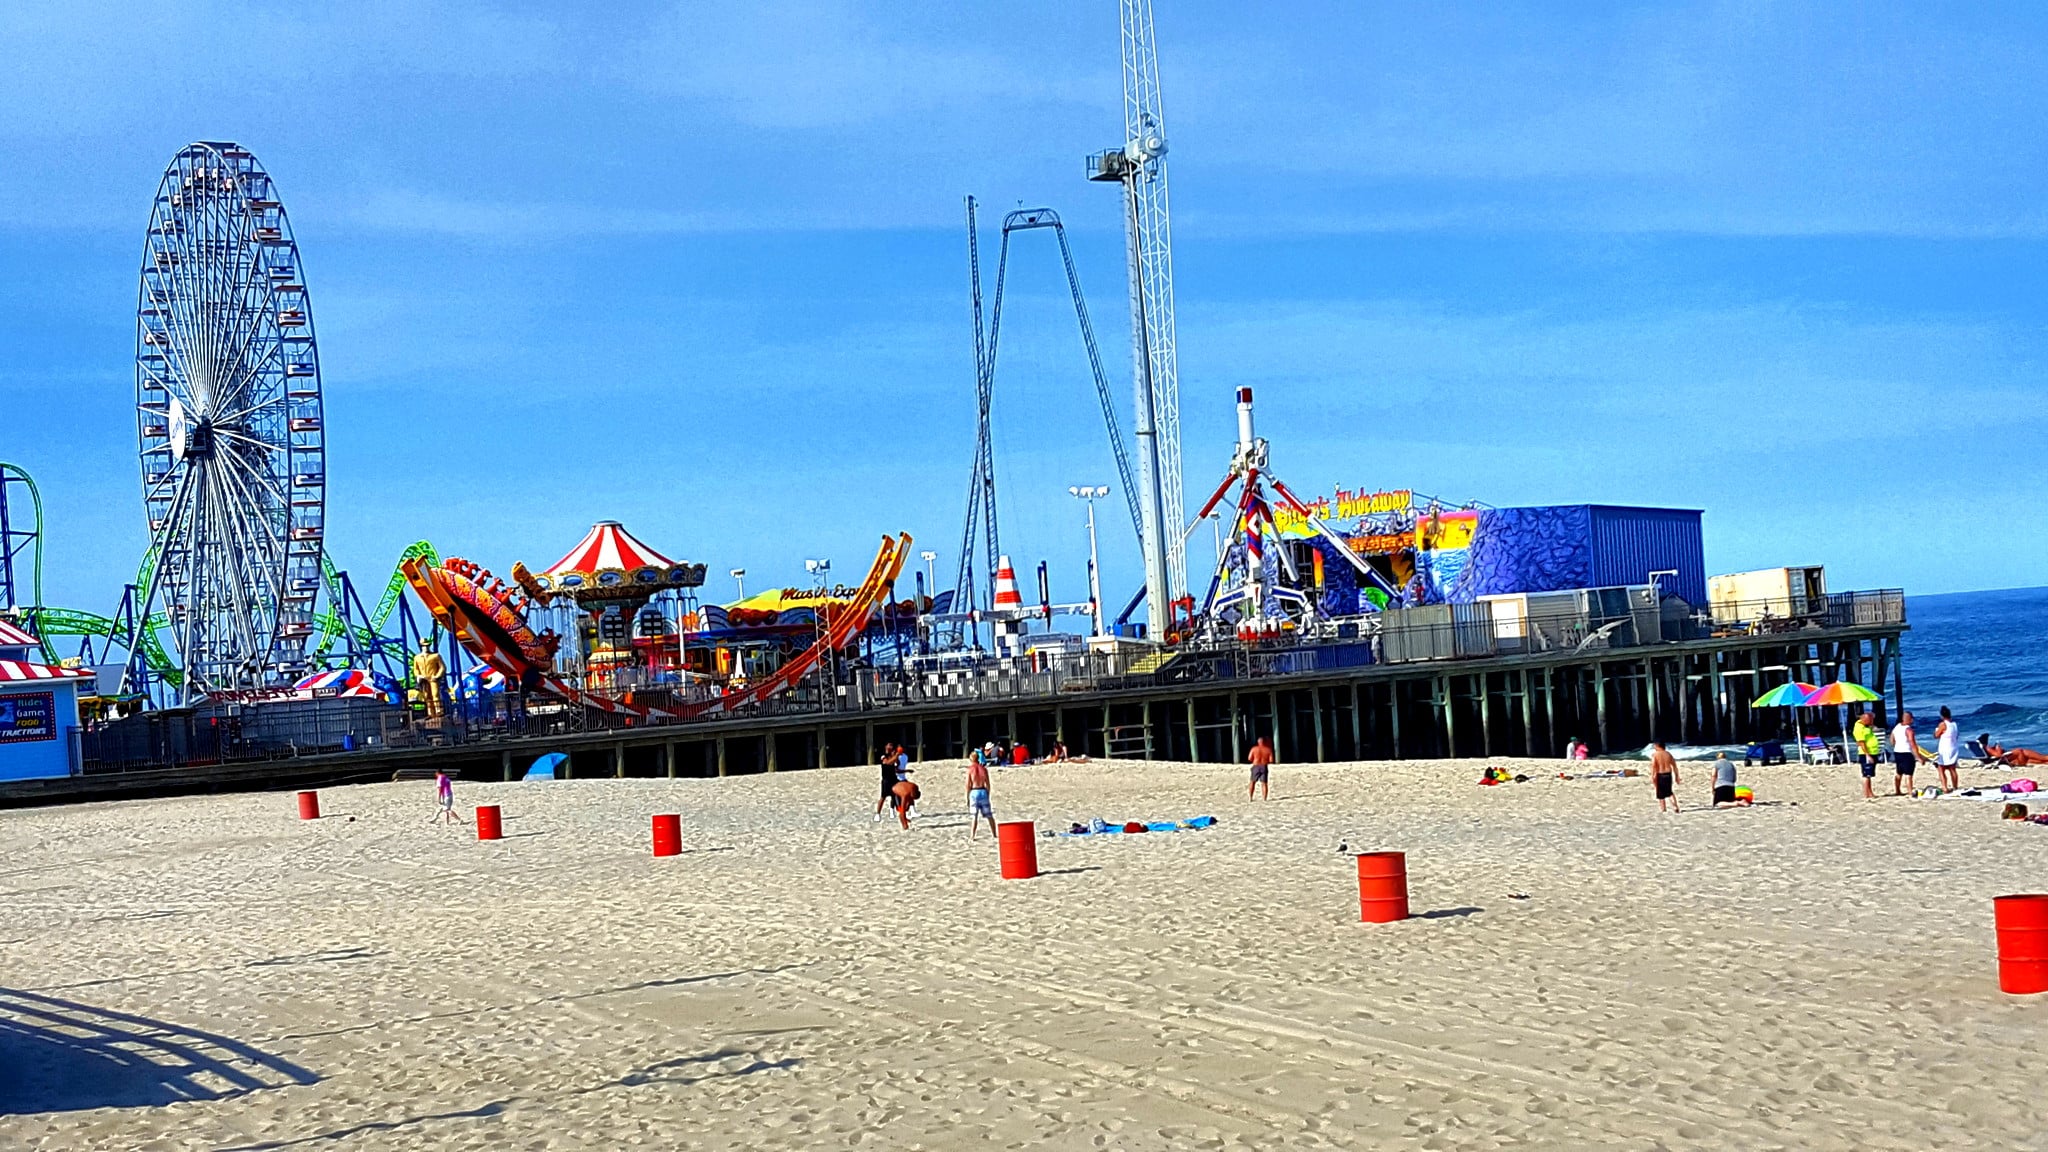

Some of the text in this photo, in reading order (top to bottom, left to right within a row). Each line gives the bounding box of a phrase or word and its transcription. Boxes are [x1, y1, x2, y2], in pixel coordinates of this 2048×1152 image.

[1336, 487, 1410, 521] Hideaway
[833, 584, 860, 600] Exp
[16, 710, 46, 718] Games
[0, 727, 47, 737] TRACTIONS
